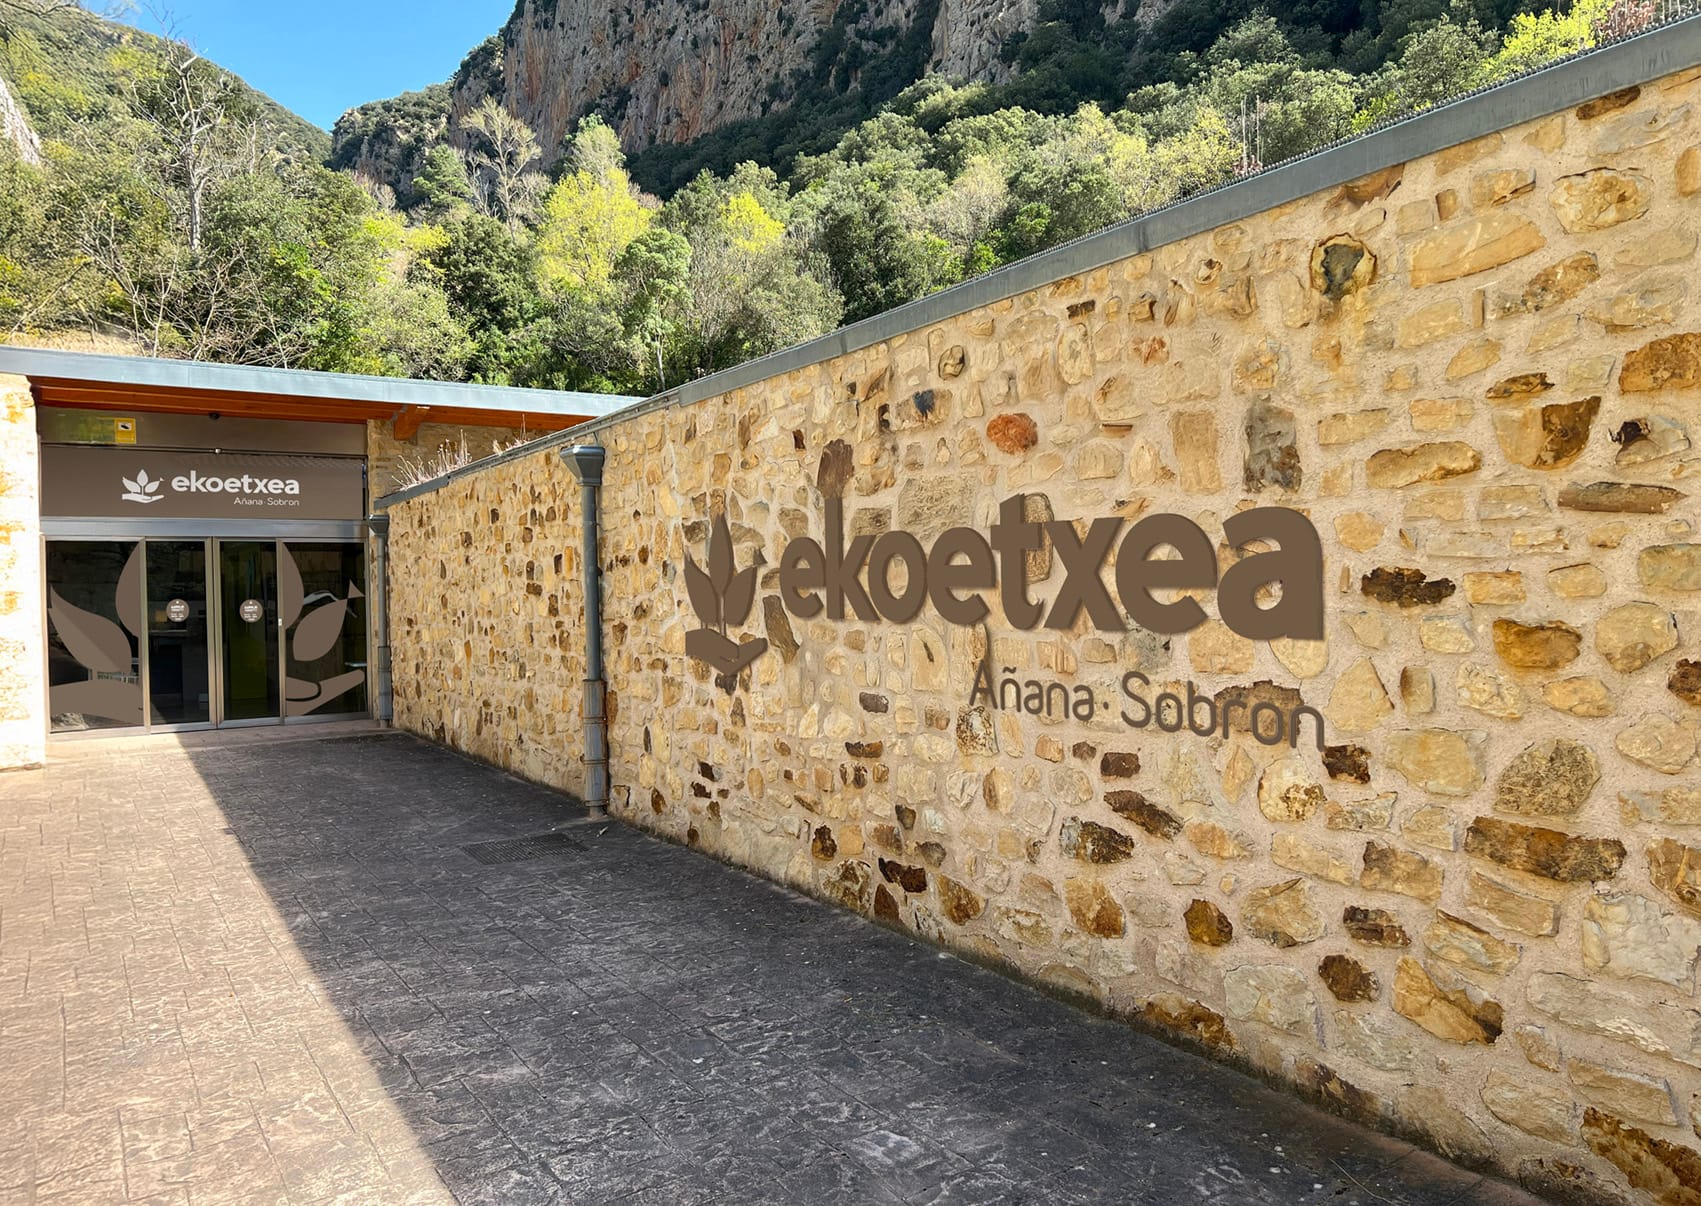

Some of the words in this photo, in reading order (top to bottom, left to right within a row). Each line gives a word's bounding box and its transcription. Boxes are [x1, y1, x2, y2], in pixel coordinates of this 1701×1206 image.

[171, 470, 300, 494] ekoetxea
[780, 492, 1324, 641] ekoetxea
[1121, 671, 1325, 751] Sobron
